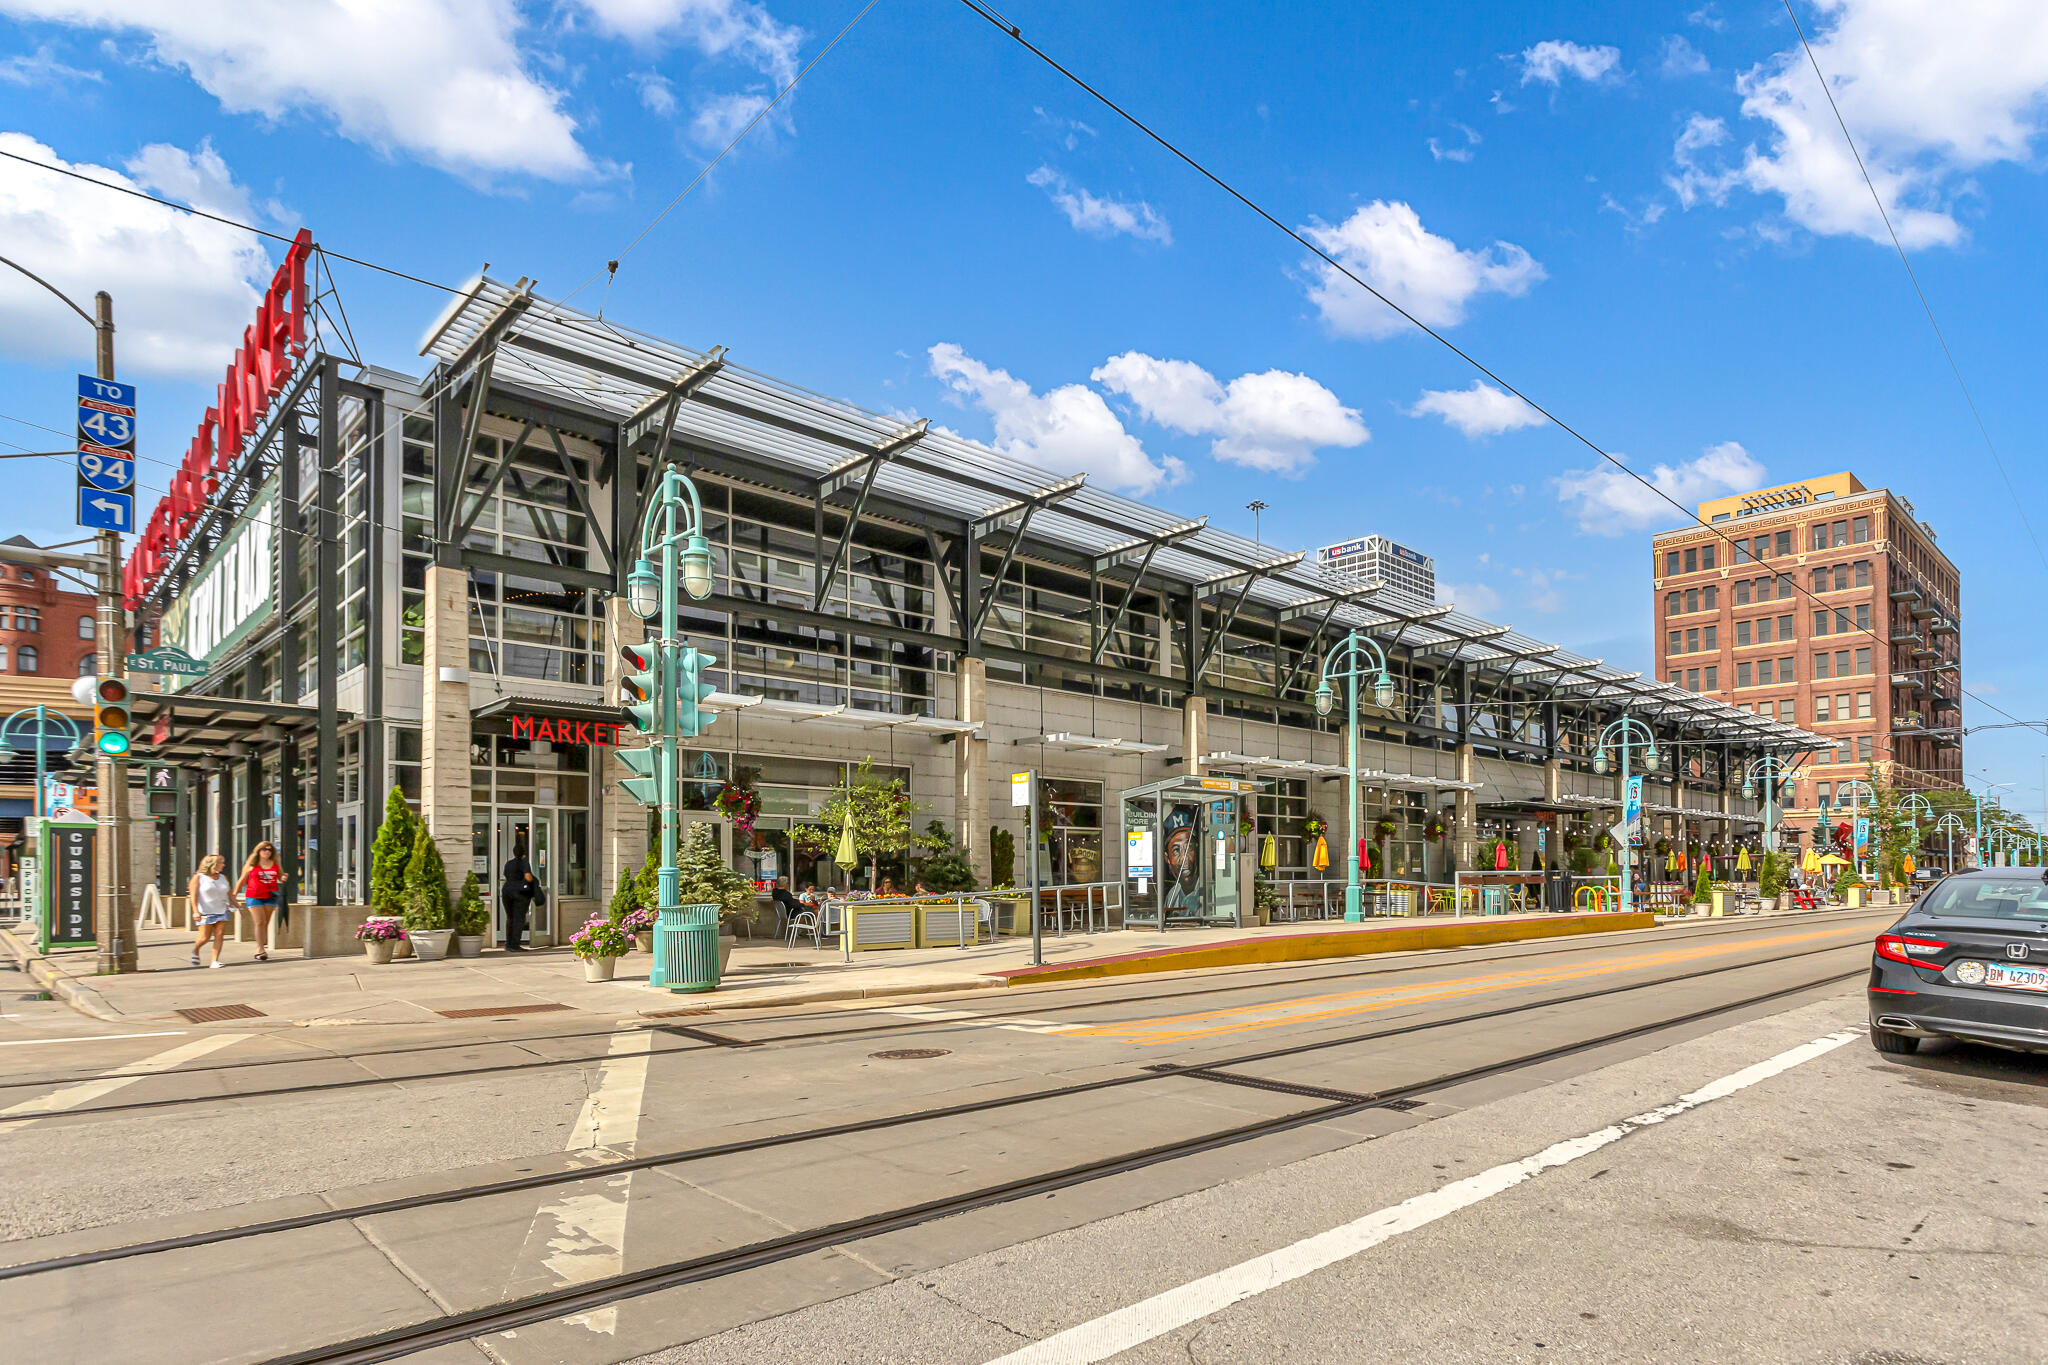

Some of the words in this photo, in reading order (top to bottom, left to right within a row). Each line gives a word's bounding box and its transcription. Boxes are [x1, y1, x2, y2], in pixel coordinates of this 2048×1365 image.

[92, 382, 122, 399] TO
[83, 412, 131, 441] 43
[80, 454, 127, 485] 94
[138, 657, 159, 670] ST.
[163, 659, 195, 672] PAUL
[512, 715, 625, 748] MARKET
[53, 783, 67, 797] 15
[24, 871, 33, 921] PCKUP
[69, 832, 84, 938] CURBSIDE
[1989, 968, 2004, 981] BM
[2009, 970, 2046, 985] 42309
